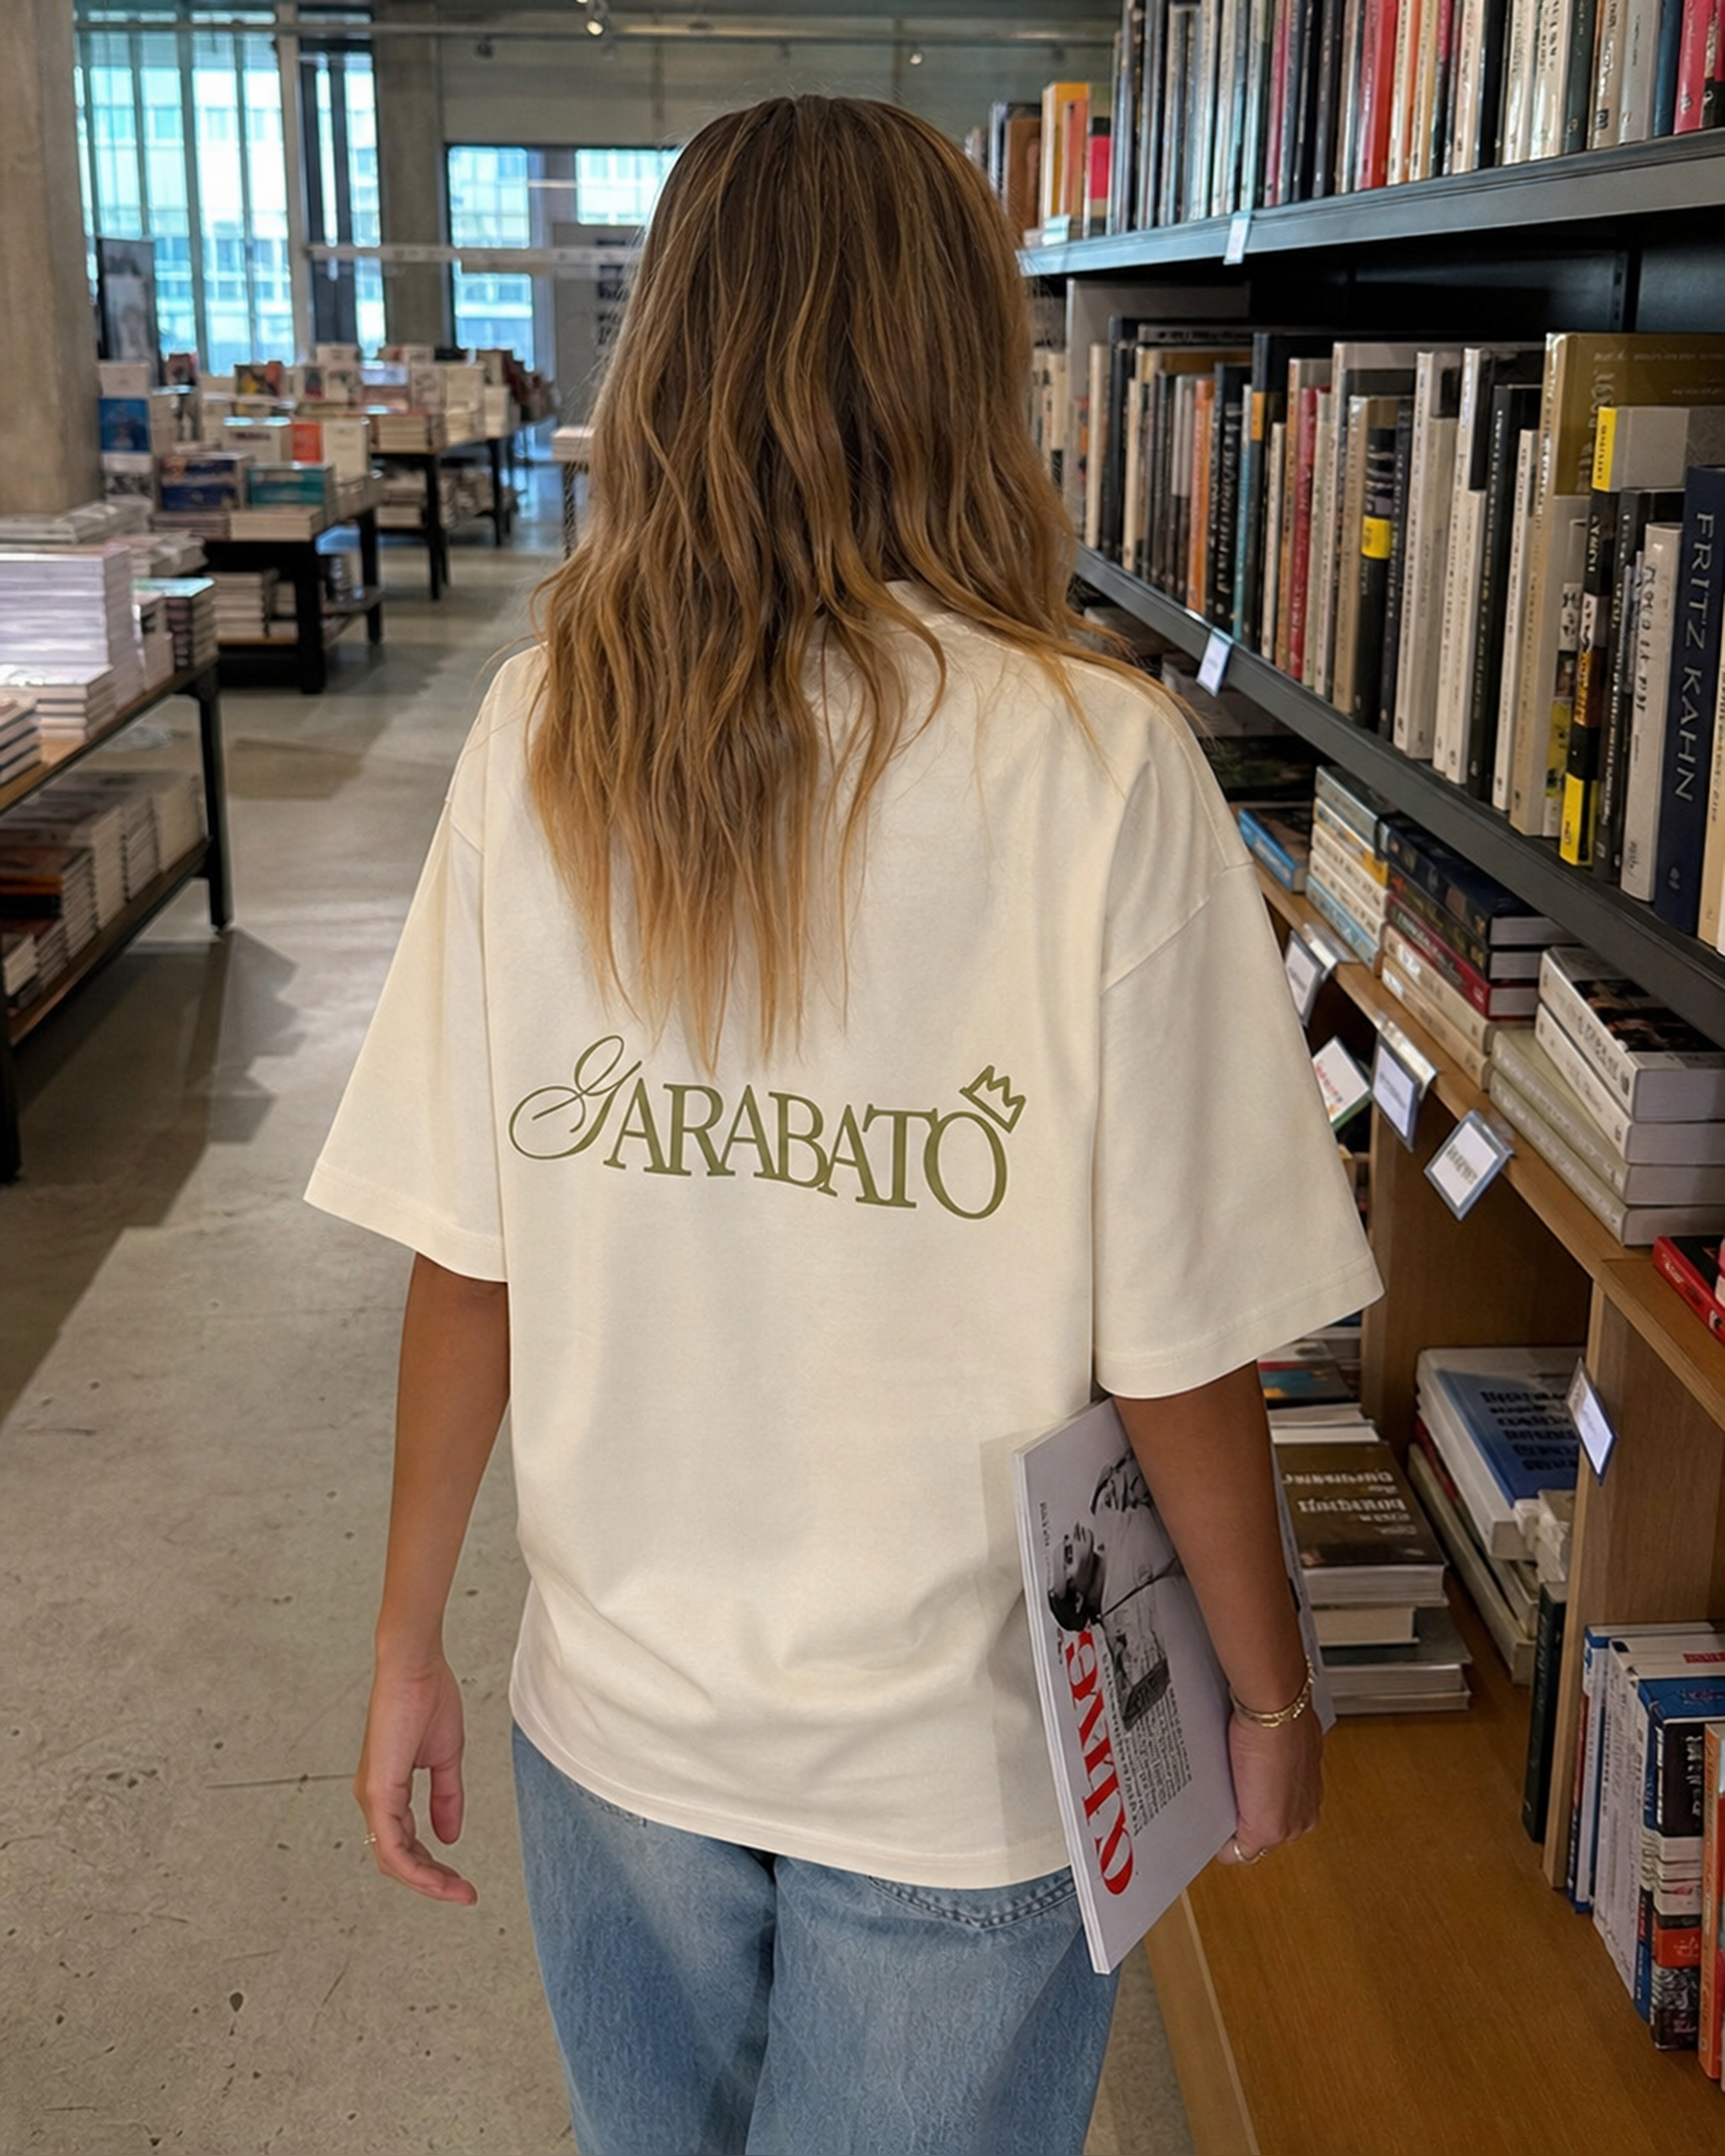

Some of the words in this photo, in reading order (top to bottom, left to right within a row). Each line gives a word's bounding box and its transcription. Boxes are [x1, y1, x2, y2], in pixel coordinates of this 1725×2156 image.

[1686, 512, 1715, 650] FRITZ
[1674, 666, 1702, 801] KAHN
[509, 1035, 1008, 1219] GARABATO
